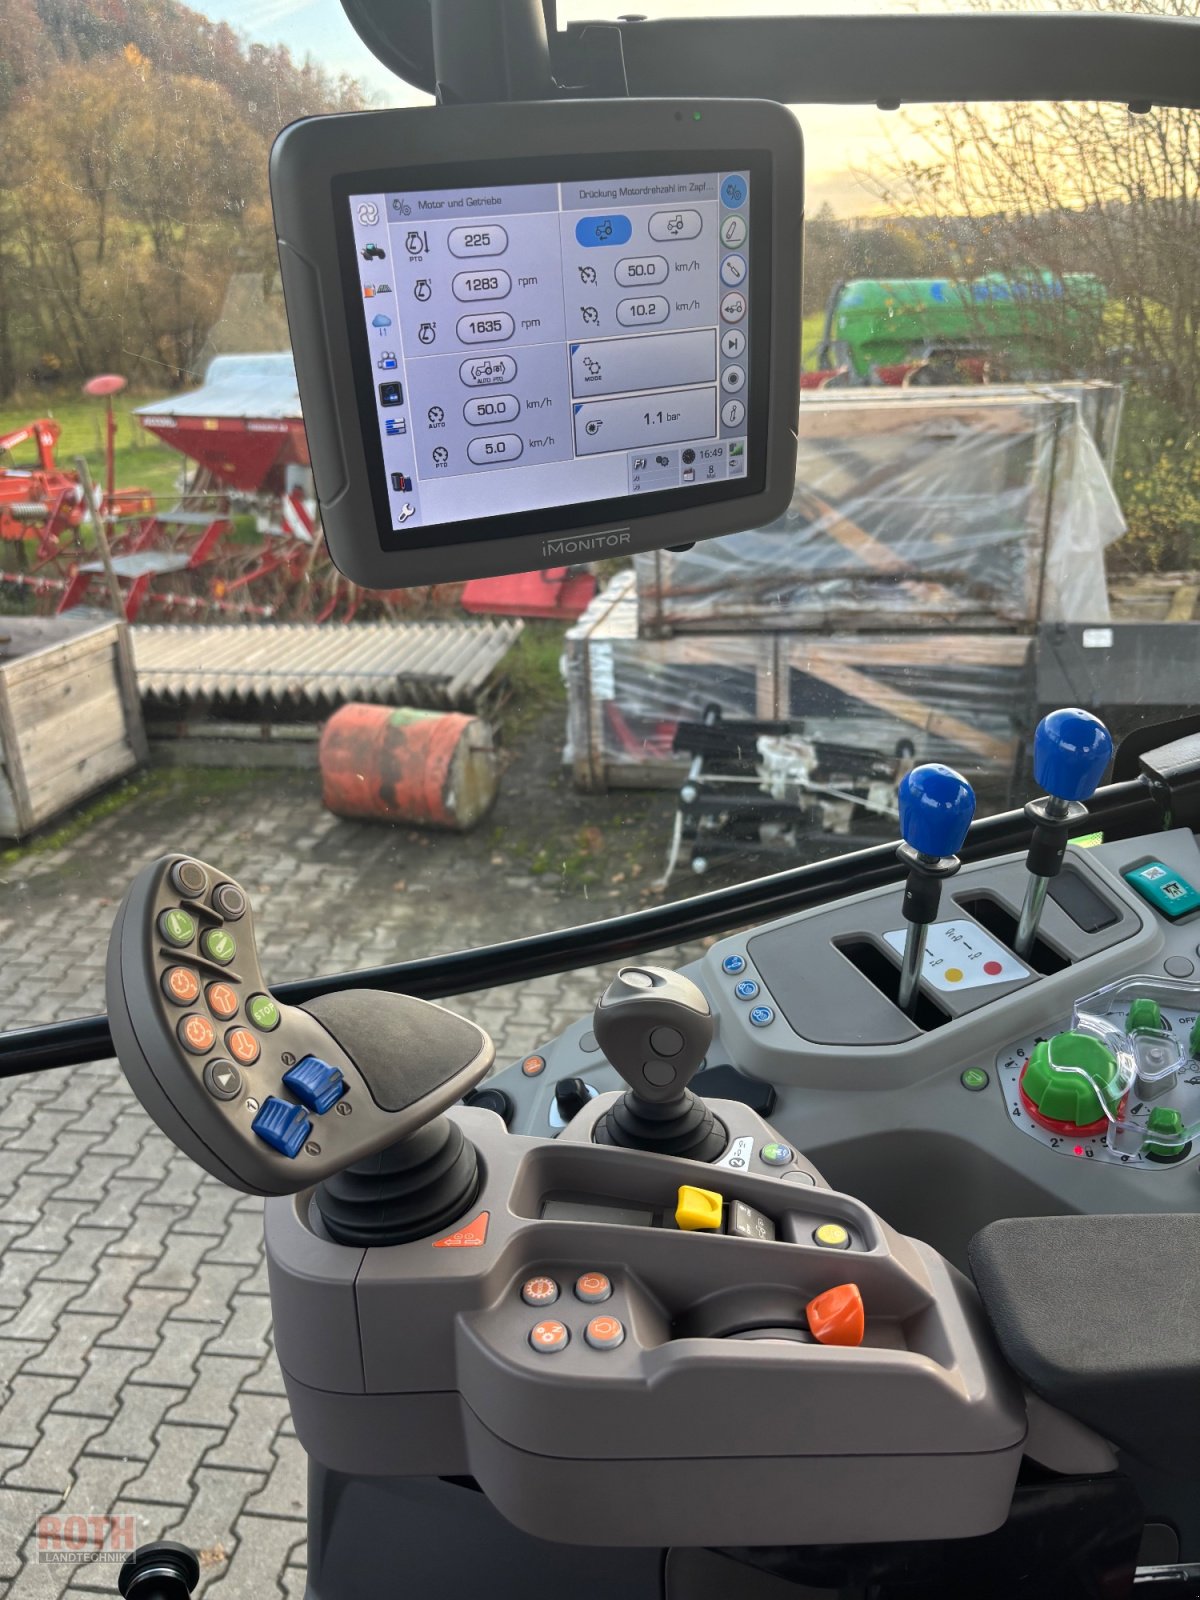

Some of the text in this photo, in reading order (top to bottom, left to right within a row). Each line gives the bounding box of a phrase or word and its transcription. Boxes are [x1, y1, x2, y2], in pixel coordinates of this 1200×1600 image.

[579, 189, 617, 199] Drückung
[620, 184, 676, 196] Motordrehzahl
[677, 184, 688, 192] im
[418, 197, 502, 210] Motor und Getriebe
[464, 233, 491, 247] 225
[628, 260, 700, 277] 50.0 km/h
[465, 277, 538, 291] 1283 rpm
[630, 300, 700, 317] 10.2 km/h
[469, 319, 541, 334] 1635 rpm
[477, 397, 552, 416] 50.0 km/h
[643, 411, 681, 425] 1.1 bar
[485, 437, 555, 455] 5.0 km/h
[700, 447, 723, 459] 16:49
[634, 459, 647, 470] F1
[708, 465, 714, 474] 8
[541, 532, 631, 557] iMONITOR
[254, 1002, 276, 1021] STOP
[1178, 1016, 1197, 1024] OFF
[1016, 1048, 1025, 1057] 6
[1012, 1107, 1022, 1117] 4
[1050, 1137, 1059, 1147] 2
